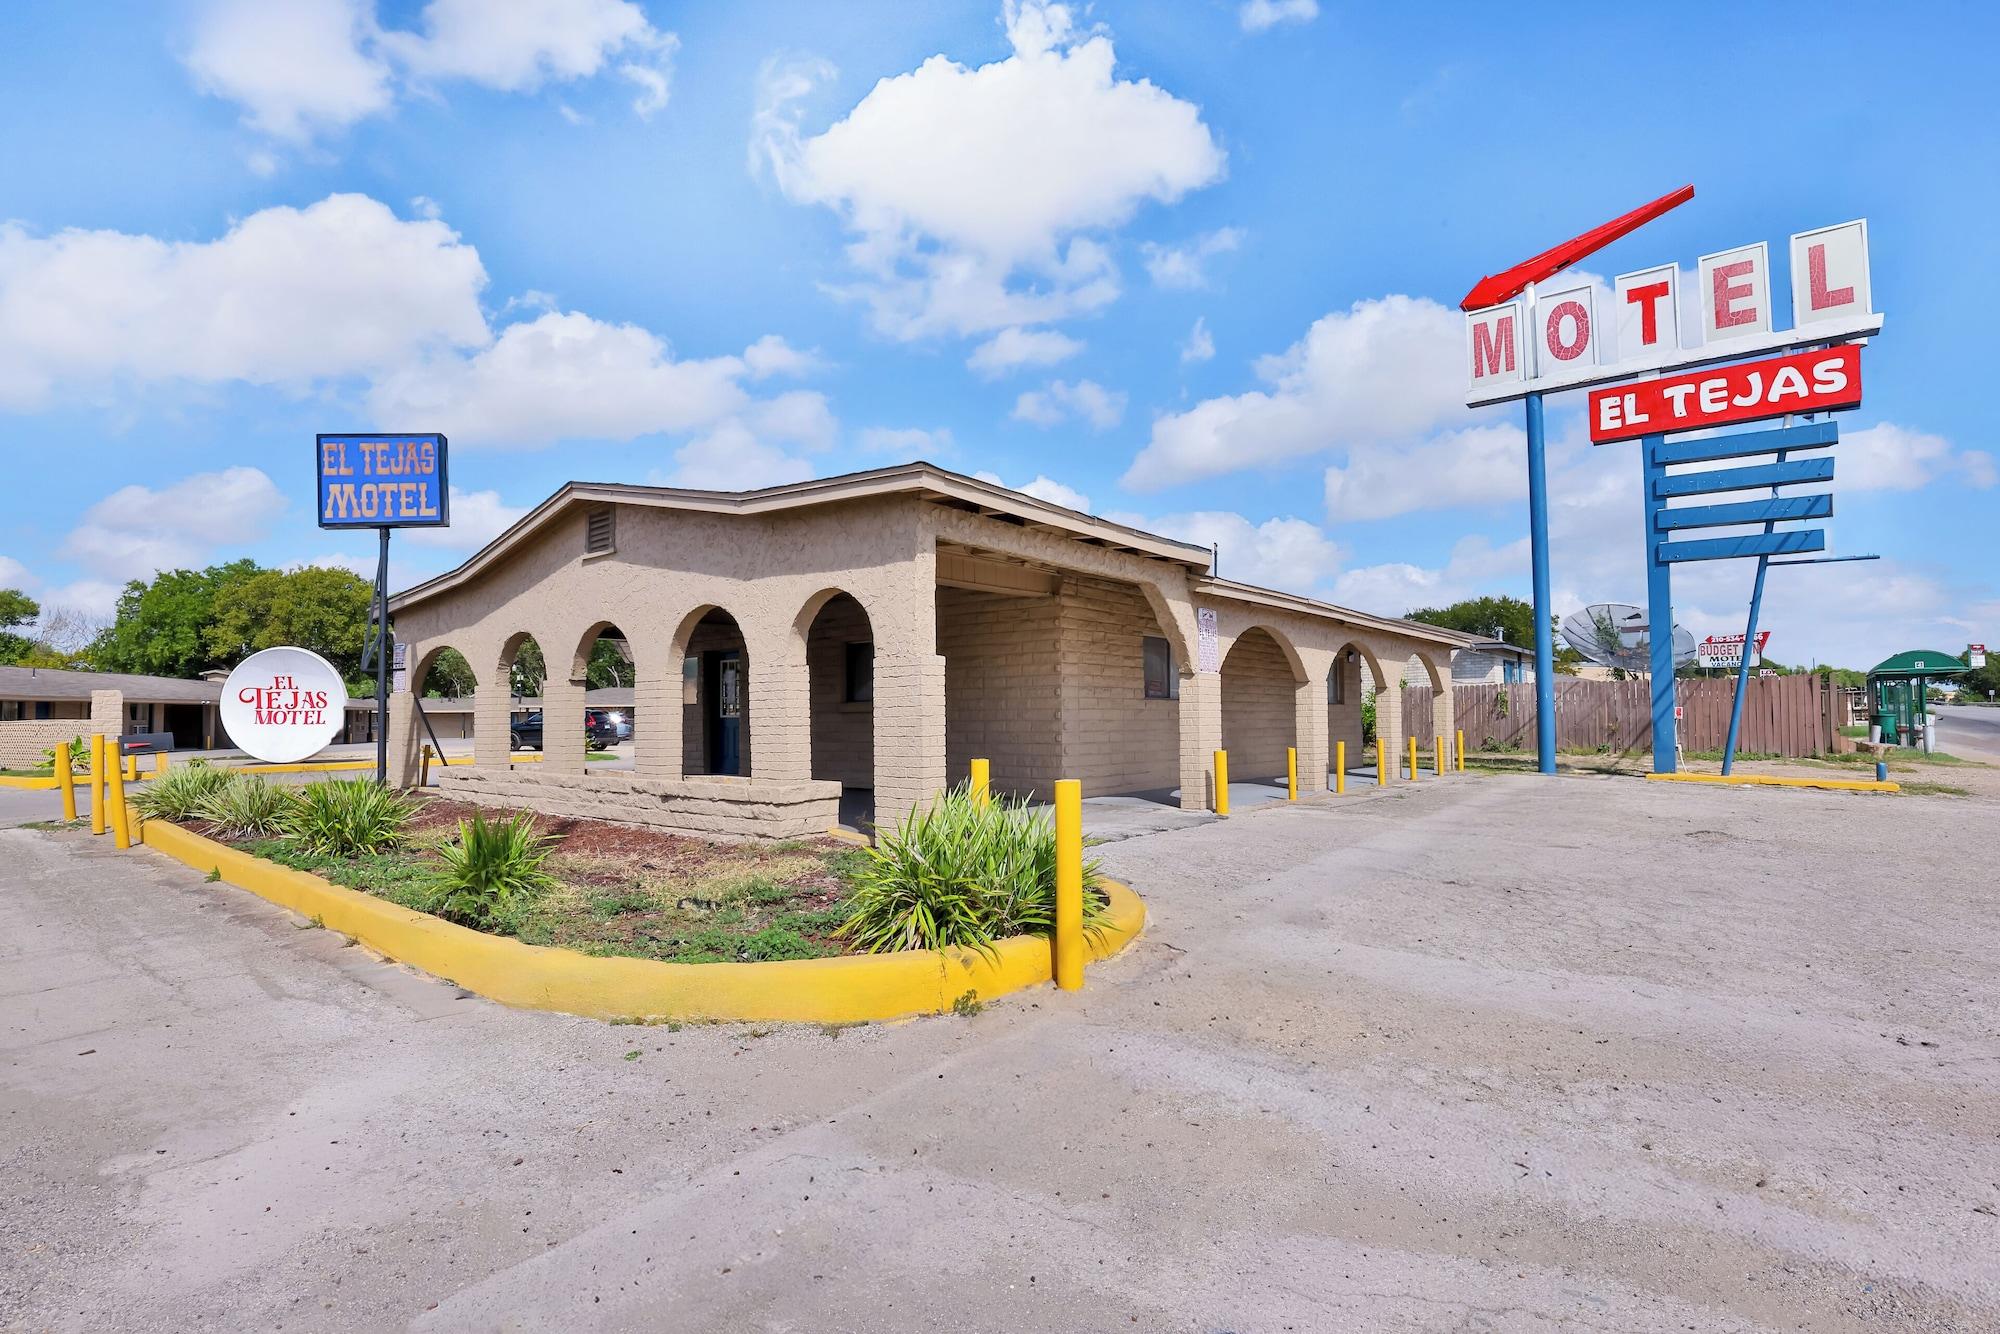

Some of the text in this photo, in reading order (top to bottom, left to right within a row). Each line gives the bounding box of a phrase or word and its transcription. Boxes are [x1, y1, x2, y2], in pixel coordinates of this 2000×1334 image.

[1473, 243, 1855, 378] MOTEL
[1599, 357, 1848, 431] EL TEJAS
[322, 442, 435, 476] EL TEJAS
[324, 482, 437, 519] MOTEL
[1701, 644, 1739, 656] BUDGET
[239, 684, 328, 710] TEJAS
[274, 676, 299, 690] EL
[254, 709, 326, 725] MOTEL
